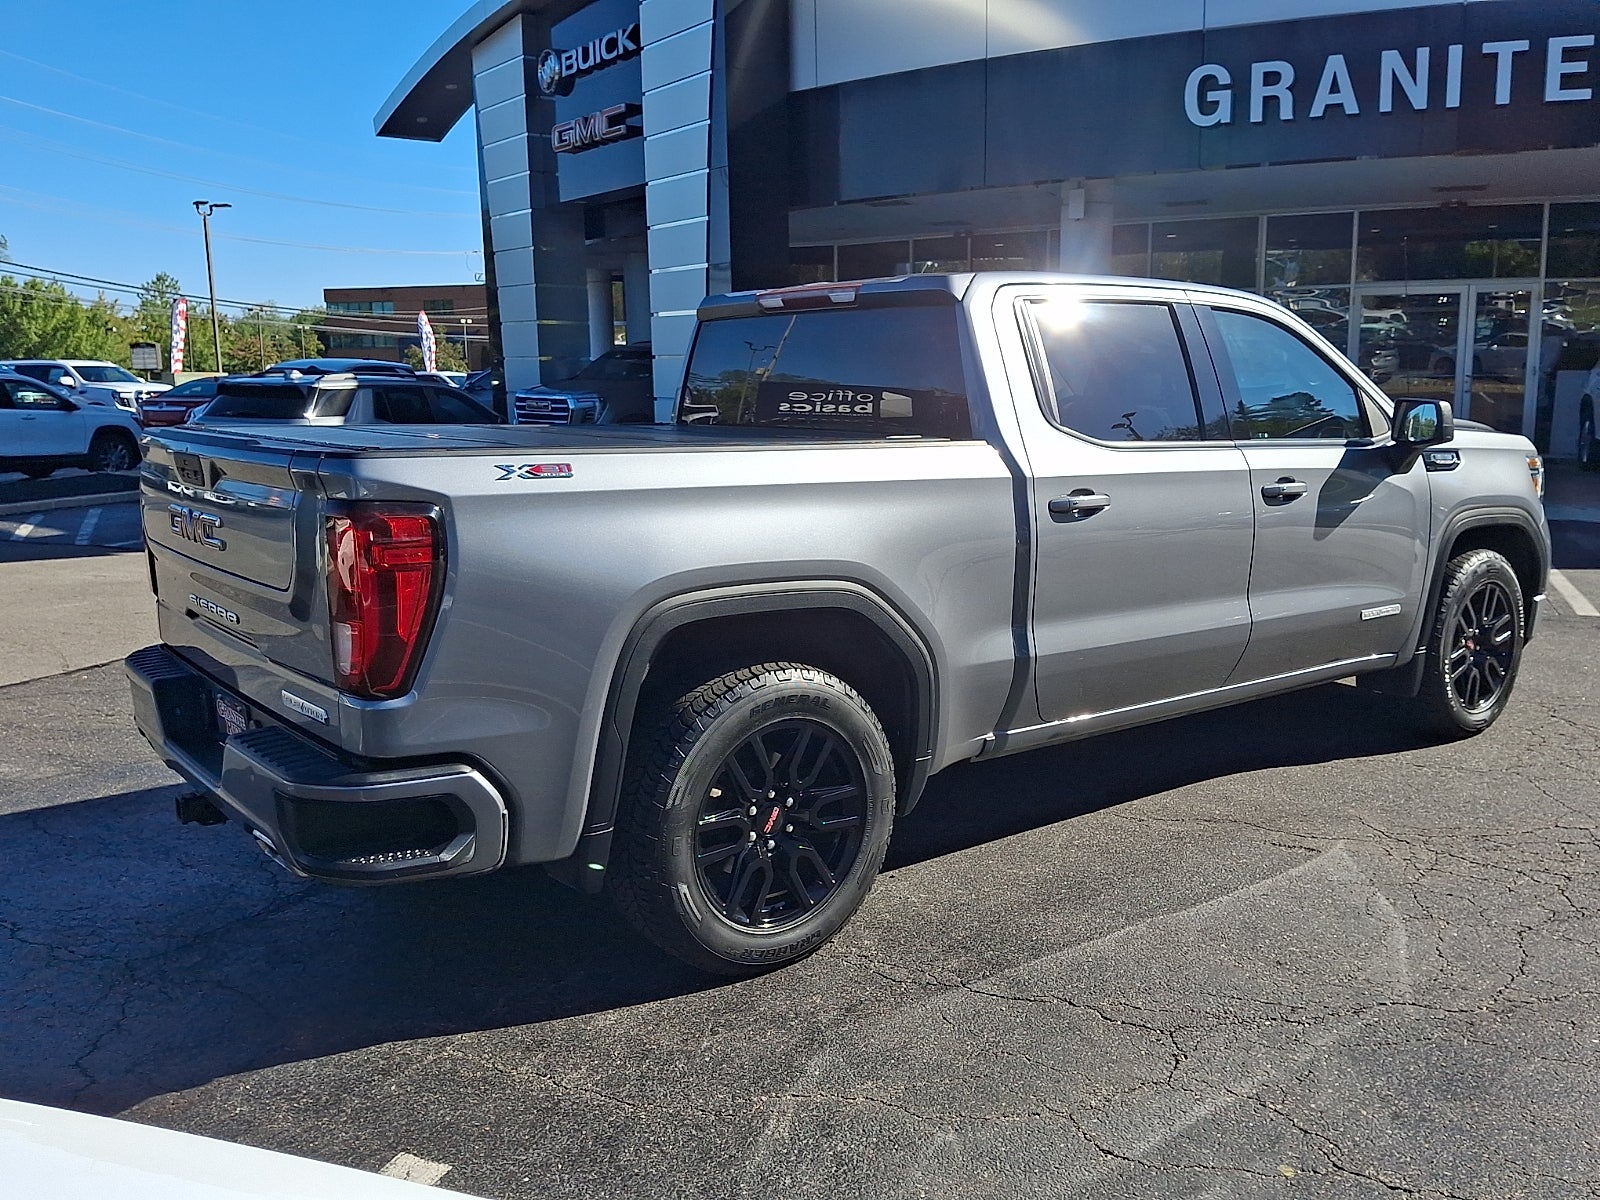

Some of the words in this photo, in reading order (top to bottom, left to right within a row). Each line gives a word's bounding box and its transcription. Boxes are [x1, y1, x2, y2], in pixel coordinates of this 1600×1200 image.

[561, 23, 637, 78] BUICK
[1184, 34, 1596, 128] GRANITE
[551, 103, 627, 153] GMC
[167, 503, 227, 551] GMC
[189, 593, 240, 625] SIERRA
